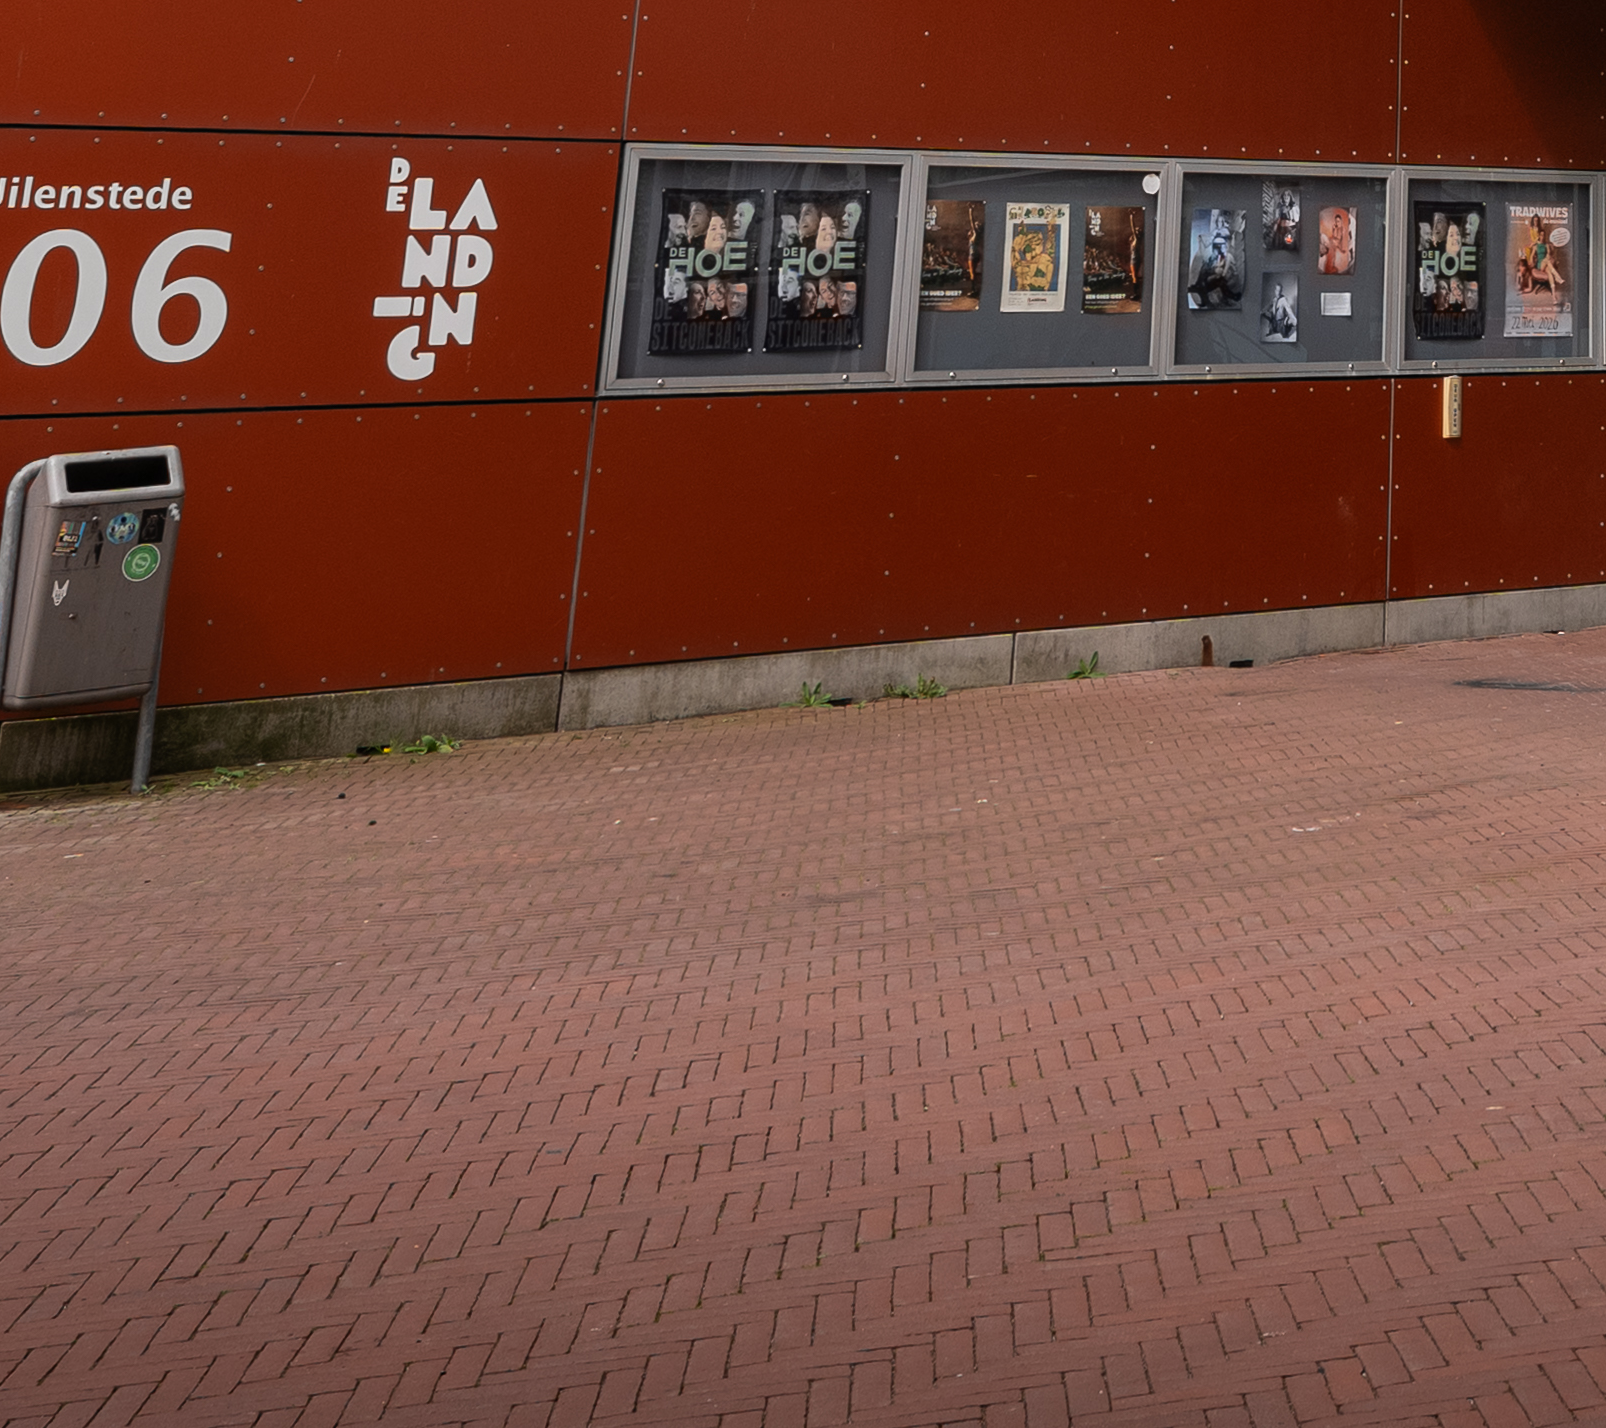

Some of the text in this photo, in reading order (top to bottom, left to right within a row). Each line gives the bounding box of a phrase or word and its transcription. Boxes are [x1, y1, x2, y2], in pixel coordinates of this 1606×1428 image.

[1509, 206, 1569, 218] TRADWIVES
[668, 241, 748, 278] HOE
[669, 248, 687, 258] DE
[782, 247, 799, 257] DE
[782, 241, 857, 277] HOE
[1421, 250, 1434, 259] DE
[1422, 246, 1477, 276] HOE
[768, 317, 861, 348] SITCOMEBACK
[1538, 316, 1559, 330] 2026
[651, 320, 750, 351] SITCOMEBACK
